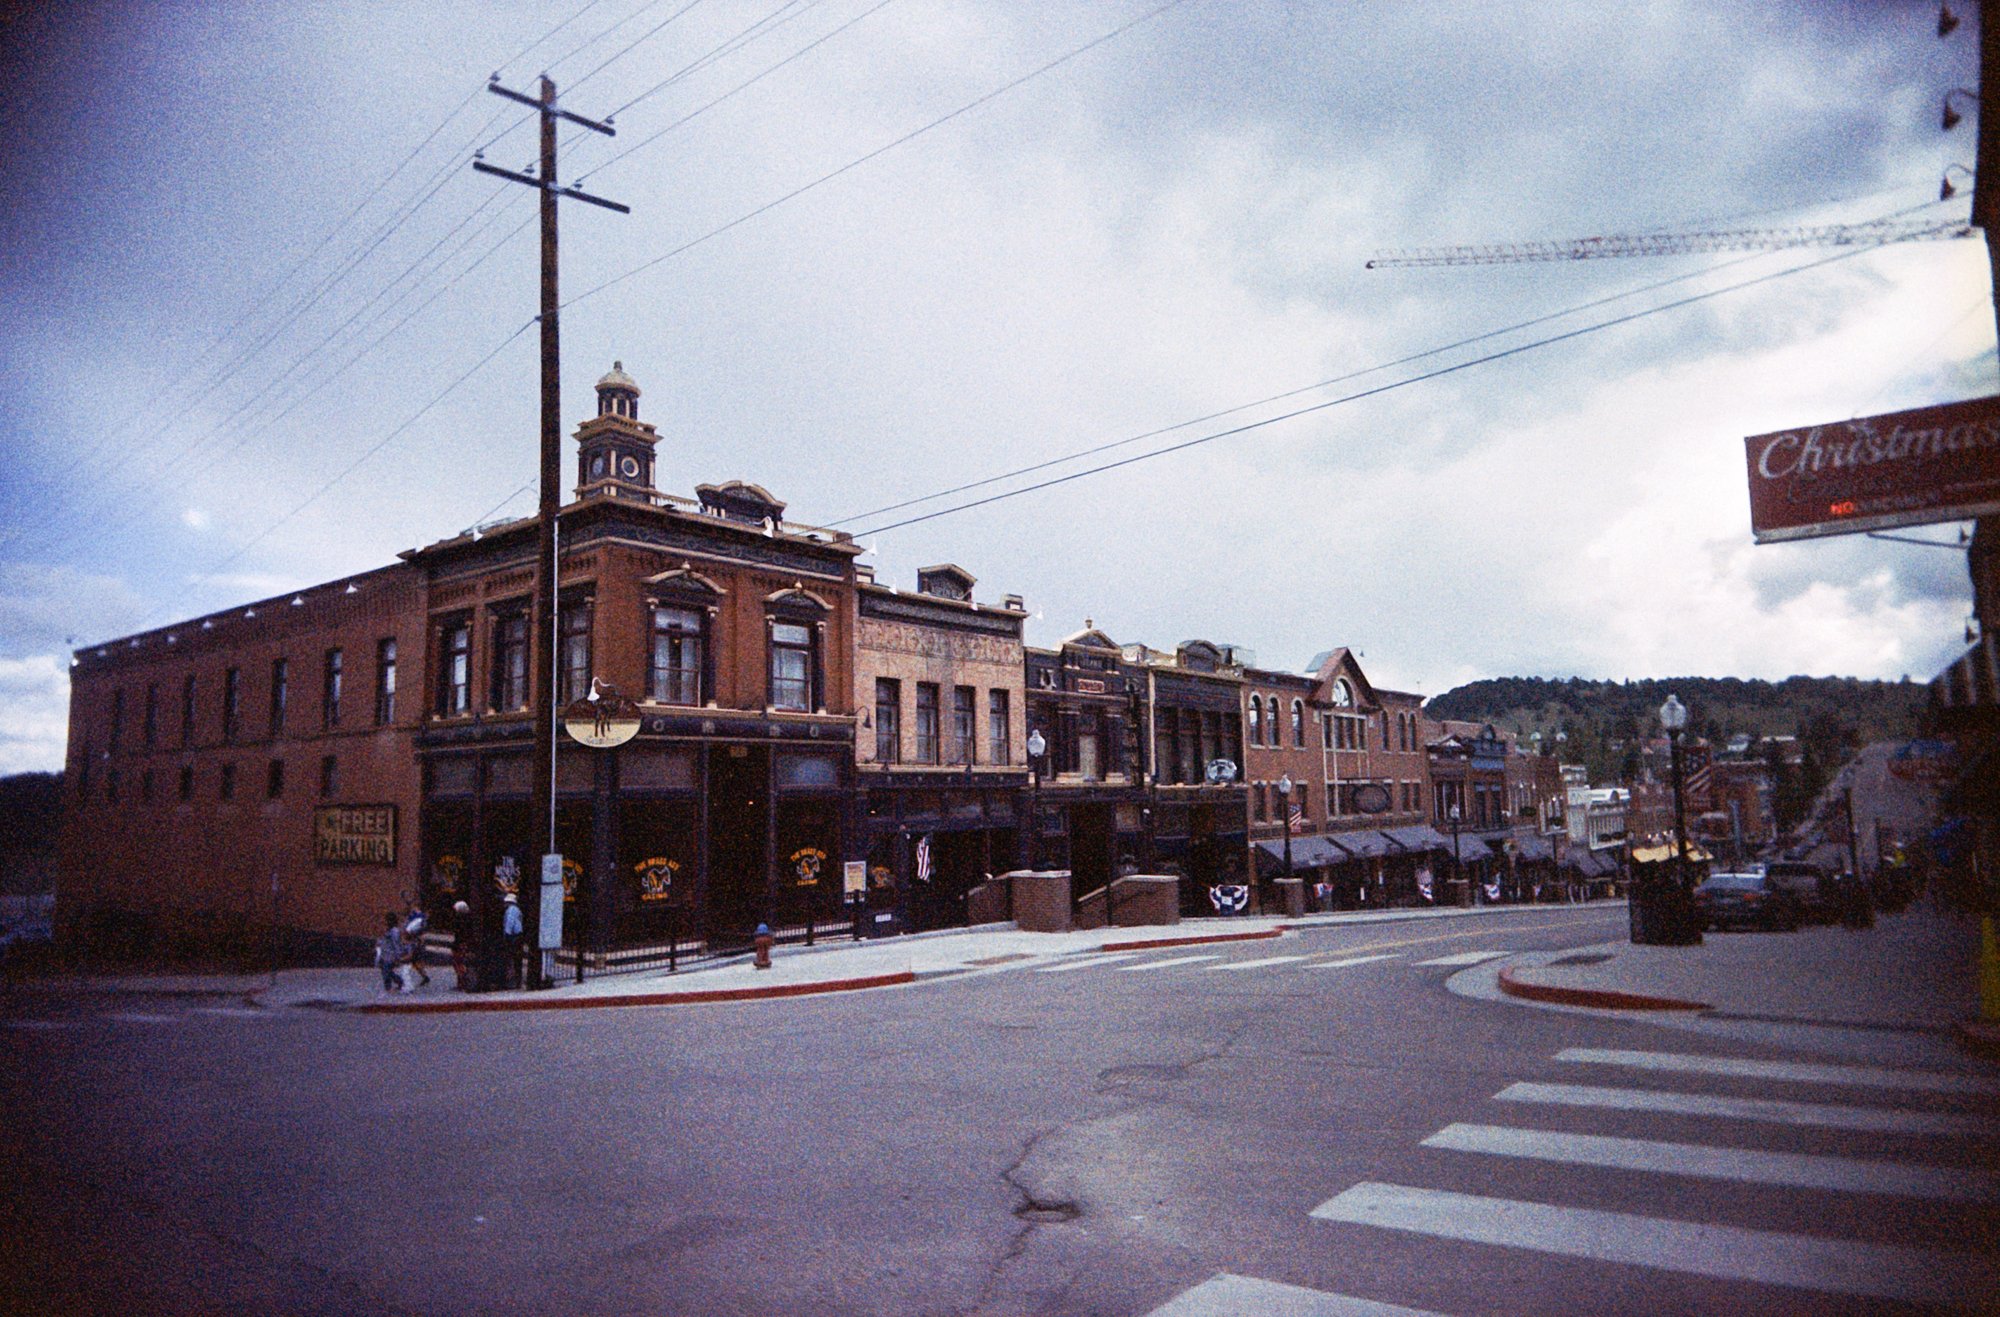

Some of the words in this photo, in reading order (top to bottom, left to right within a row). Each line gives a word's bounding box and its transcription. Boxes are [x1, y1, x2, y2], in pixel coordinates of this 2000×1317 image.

[1831, 501, 1855, 515] NO
[340, 809, 388, 834] FREE
[320, 838, 388, 861] PARKING
